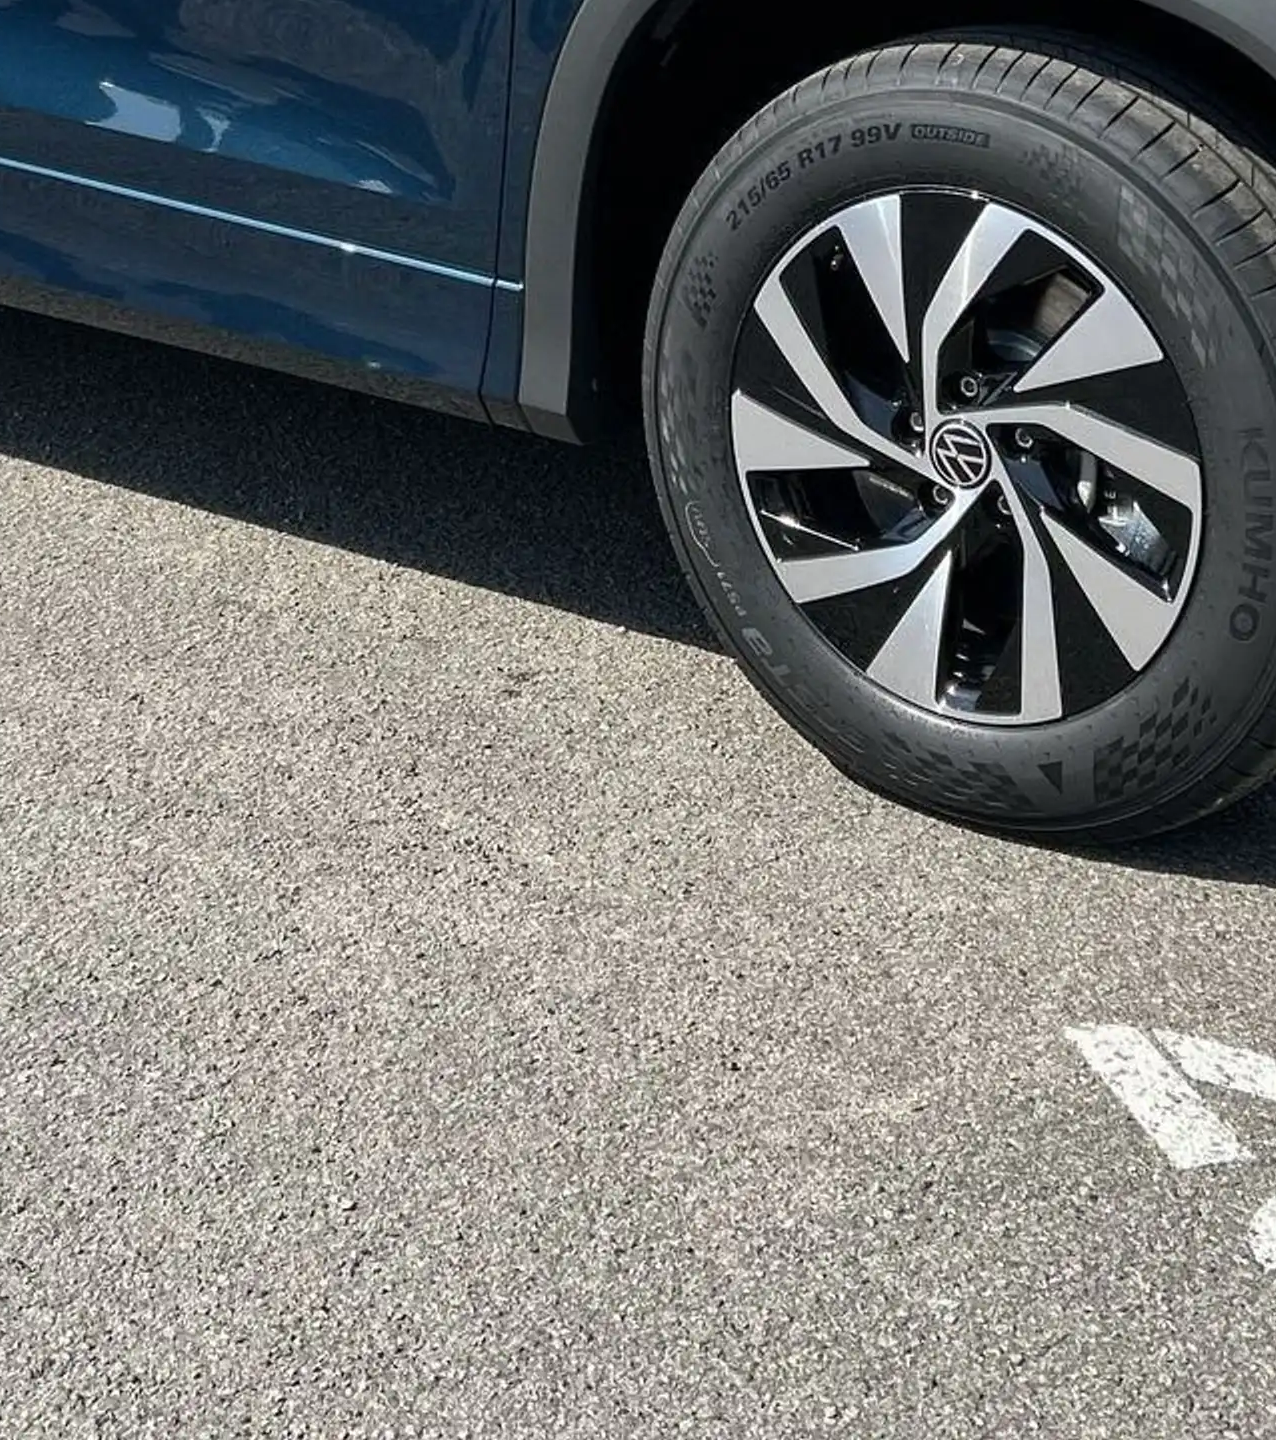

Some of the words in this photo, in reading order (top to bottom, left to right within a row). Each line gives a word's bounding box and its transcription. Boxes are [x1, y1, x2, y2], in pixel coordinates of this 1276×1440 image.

[725, 161, 792, 231] 215/65
[796, 134, 842, 169] R17
[851, 122, 901, 148] 99V
[1229, 427, 1274, 642] KUMHO
